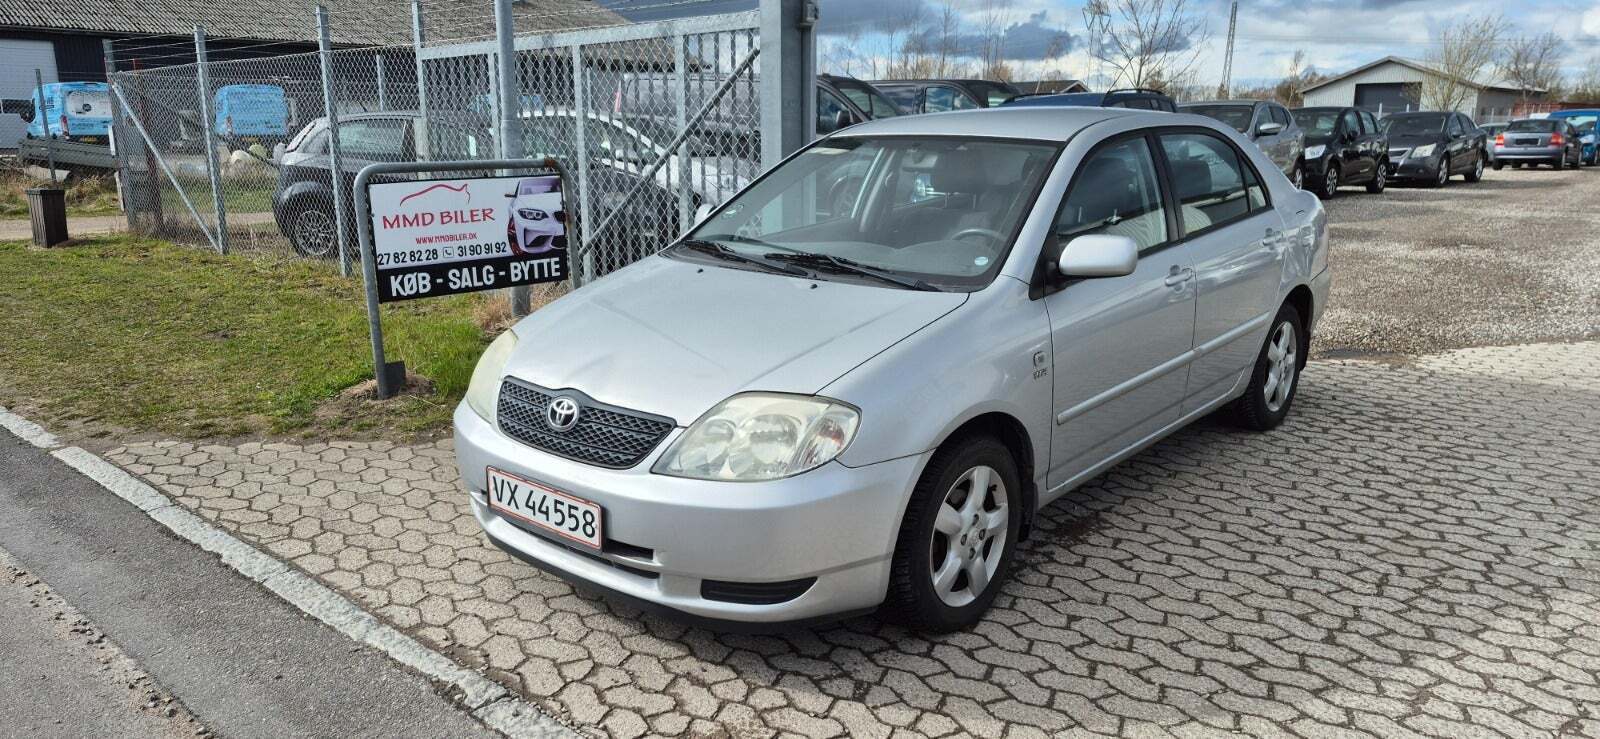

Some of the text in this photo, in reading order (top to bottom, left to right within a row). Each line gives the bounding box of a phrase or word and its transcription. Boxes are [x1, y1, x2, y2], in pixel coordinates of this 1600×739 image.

[383, 207, 495, 229] MMD BILER
[378, 242, 507, 265] 27 82 82 28 31 90 91 92
[390, 271, 431, 297] KØB
[448, 266, 495, 290] SALG
[510, 257, 561, 282] BYTTE
[492, 475, 596, 538] VX 44558
